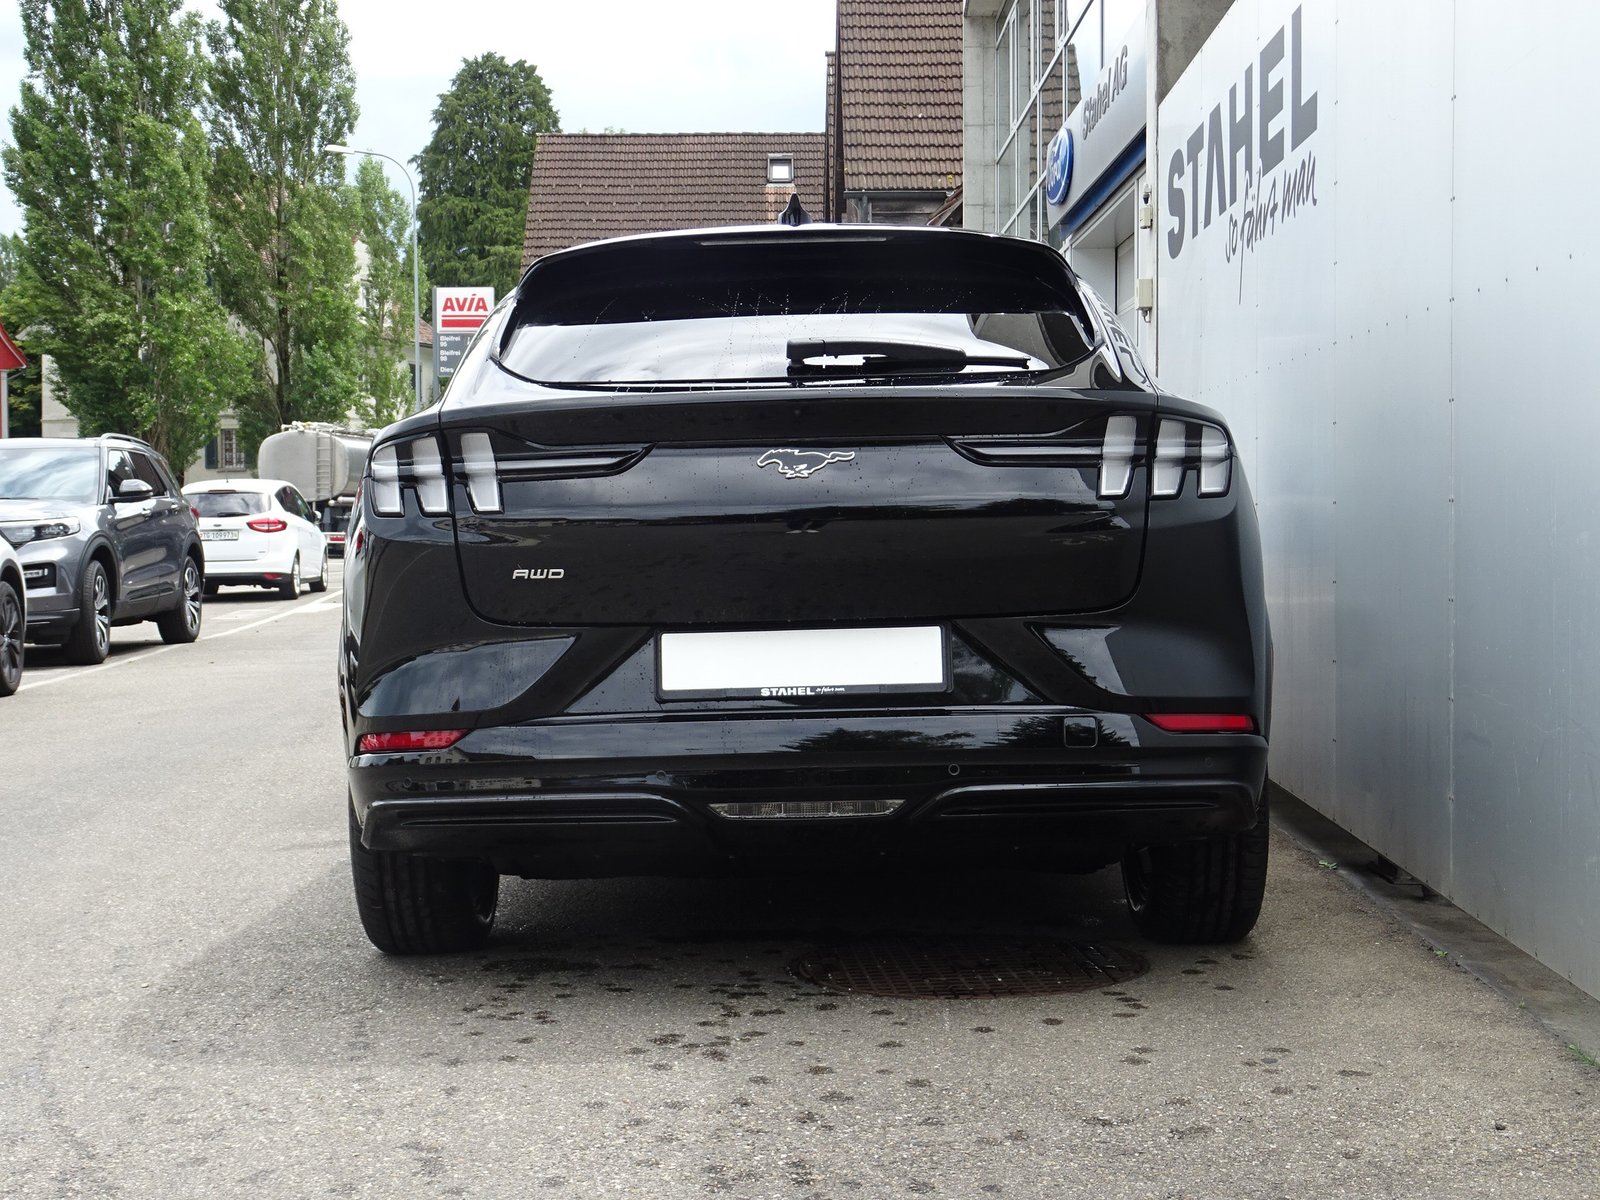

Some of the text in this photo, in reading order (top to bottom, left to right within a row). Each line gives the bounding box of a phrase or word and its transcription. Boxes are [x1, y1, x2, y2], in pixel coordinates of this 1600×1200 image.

[1082, 44, 1128, 141] Stahel AG
[1167, 3, 1318, 260] STAHEL
[1281, 150, 1318, 224] man
[512, 568, 565, 580] AWD
[760, 687, 815, 697] STAHEL
